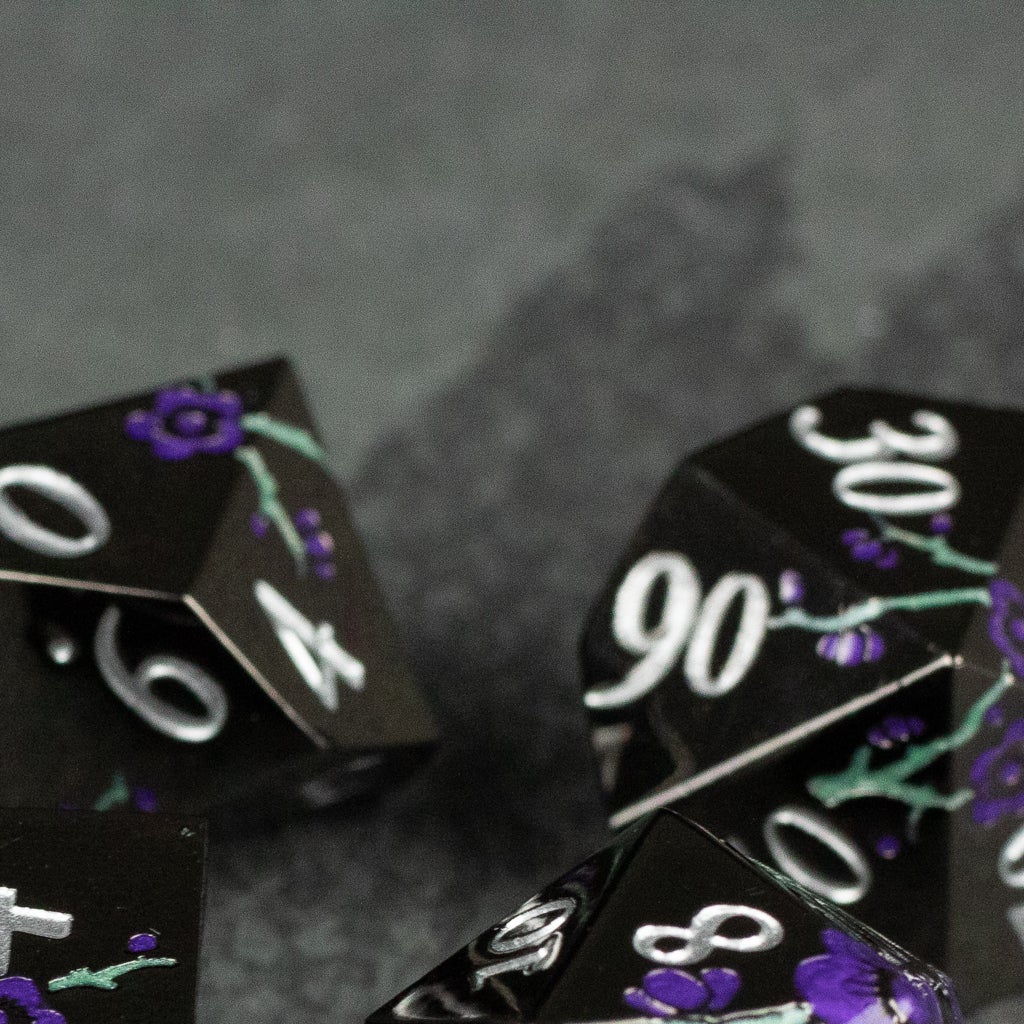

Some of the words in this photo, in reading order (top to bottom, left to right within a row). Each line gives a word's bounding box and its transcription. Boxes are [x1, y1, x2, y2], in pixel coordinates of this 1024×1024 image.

[788, 404, 962, 516] 30
[254, 579, 365, 710] 4
[584, 551, 771, 699] 90
[633, 904, 785, 964] 8
